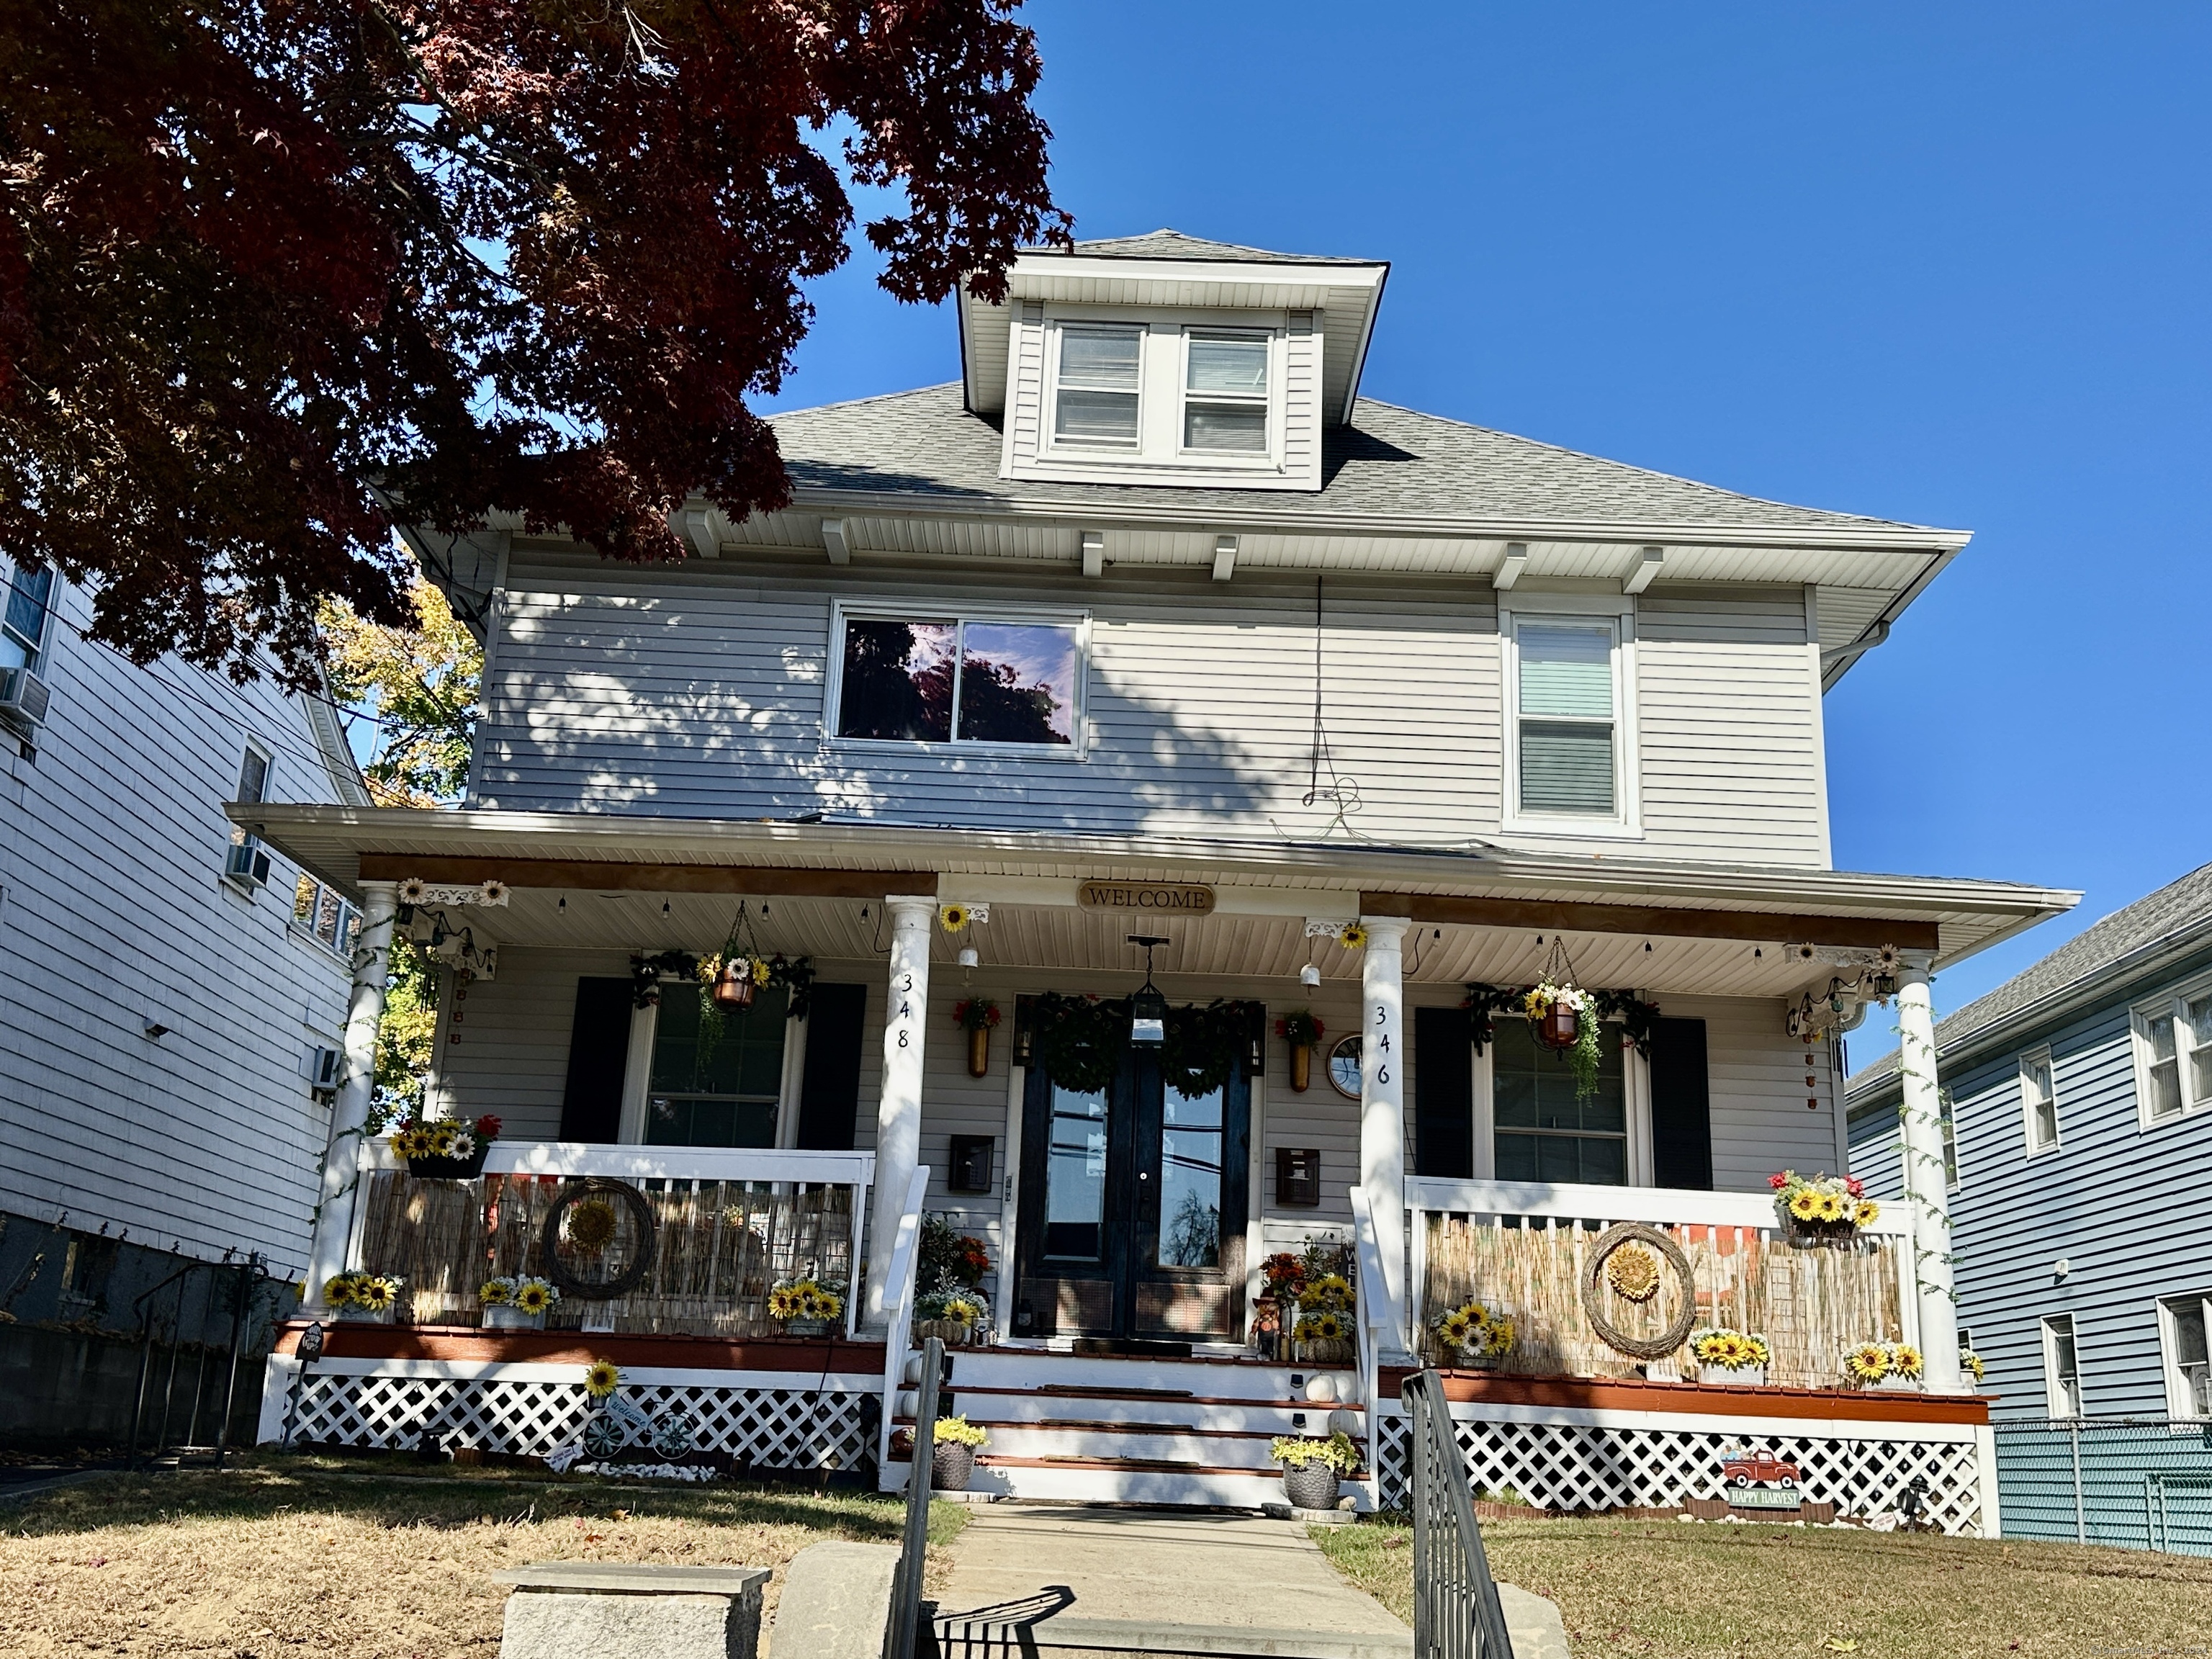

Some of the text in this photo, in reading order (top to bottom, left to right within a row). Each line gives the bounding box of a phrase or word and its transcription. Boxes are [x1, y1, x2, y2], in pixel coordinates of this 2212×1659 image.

[1088, 888, 1206, 909] WELCOME
[898, 974, 912, 1048] 348
[1375, 1006, 1390, 1084] 346
[611, 1401, 647, 1426] Welcome
[1731, 1490, 1798, 1505] HAPPY HARVEST
